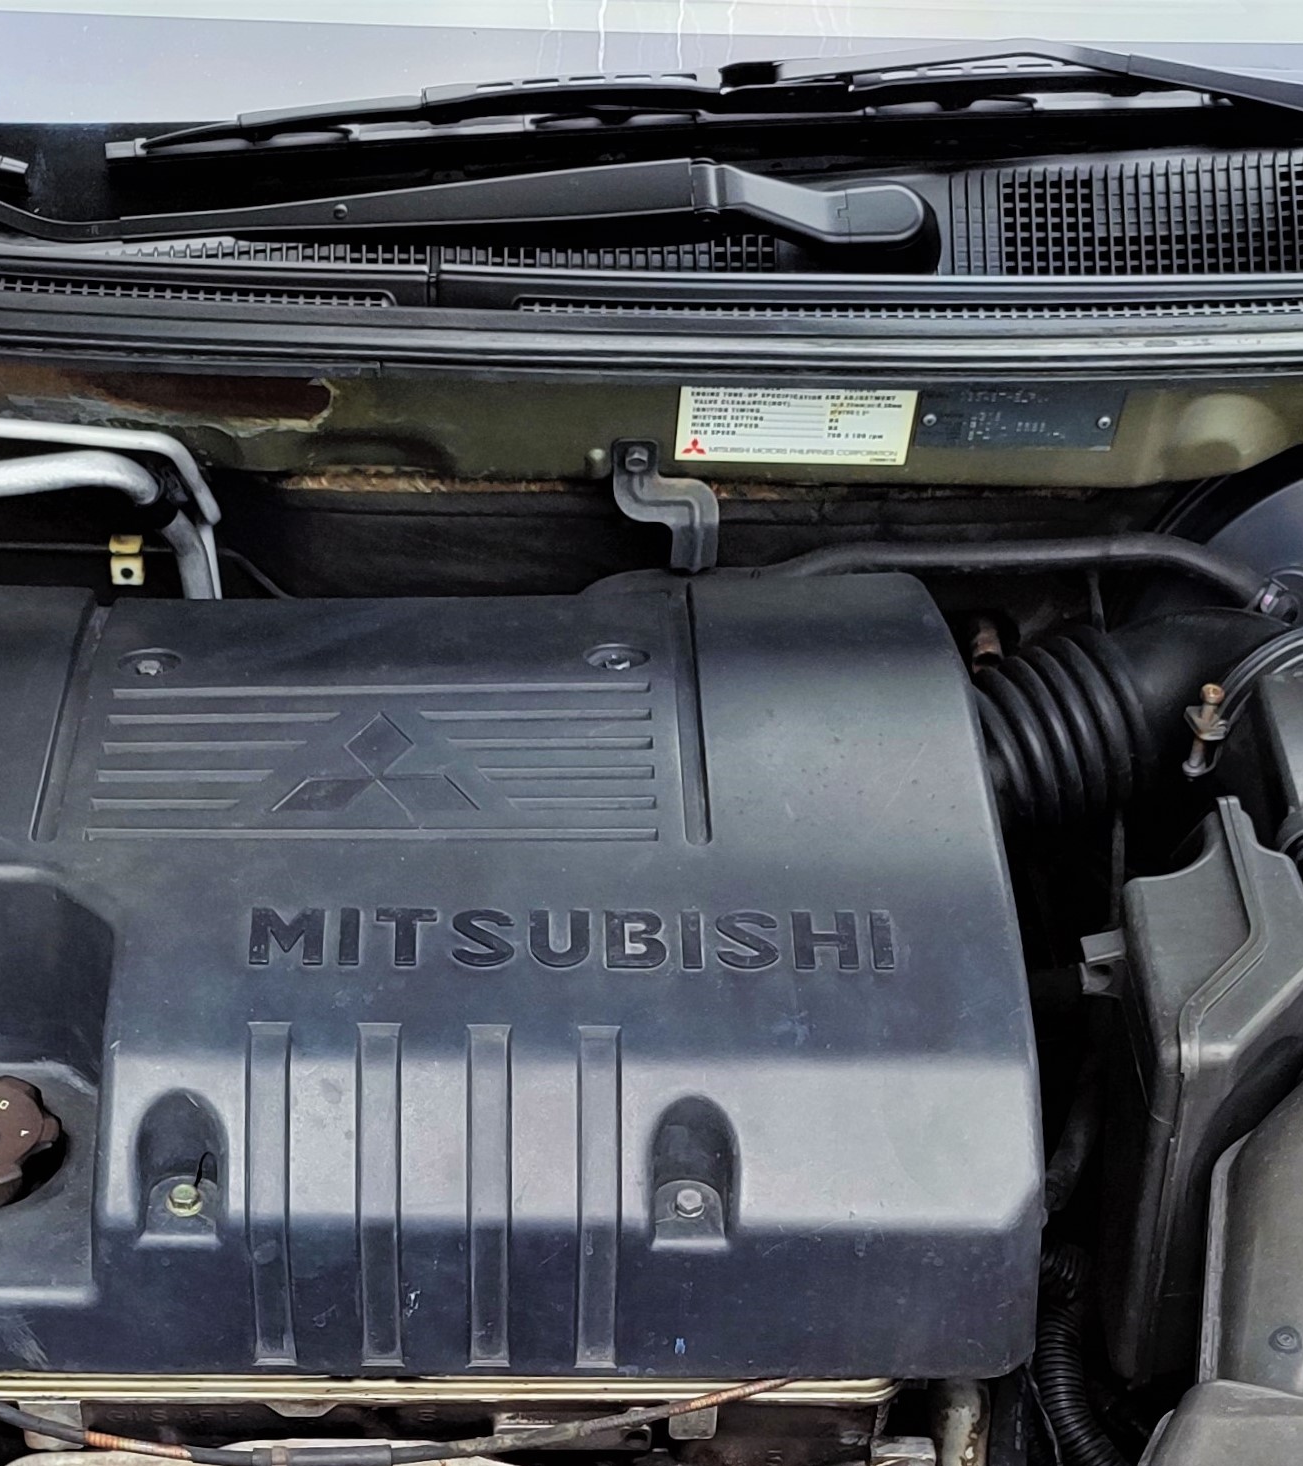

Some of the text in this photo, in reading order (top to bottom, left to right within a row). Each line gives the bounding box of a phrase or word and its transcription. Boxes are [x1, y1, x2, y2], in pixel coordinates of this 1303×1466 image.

[753, 447, 788, 455] MOTORS
[836, 449, 898, 457] CORPORATION
[248, 908, 895, 970] MITSUBISHI
